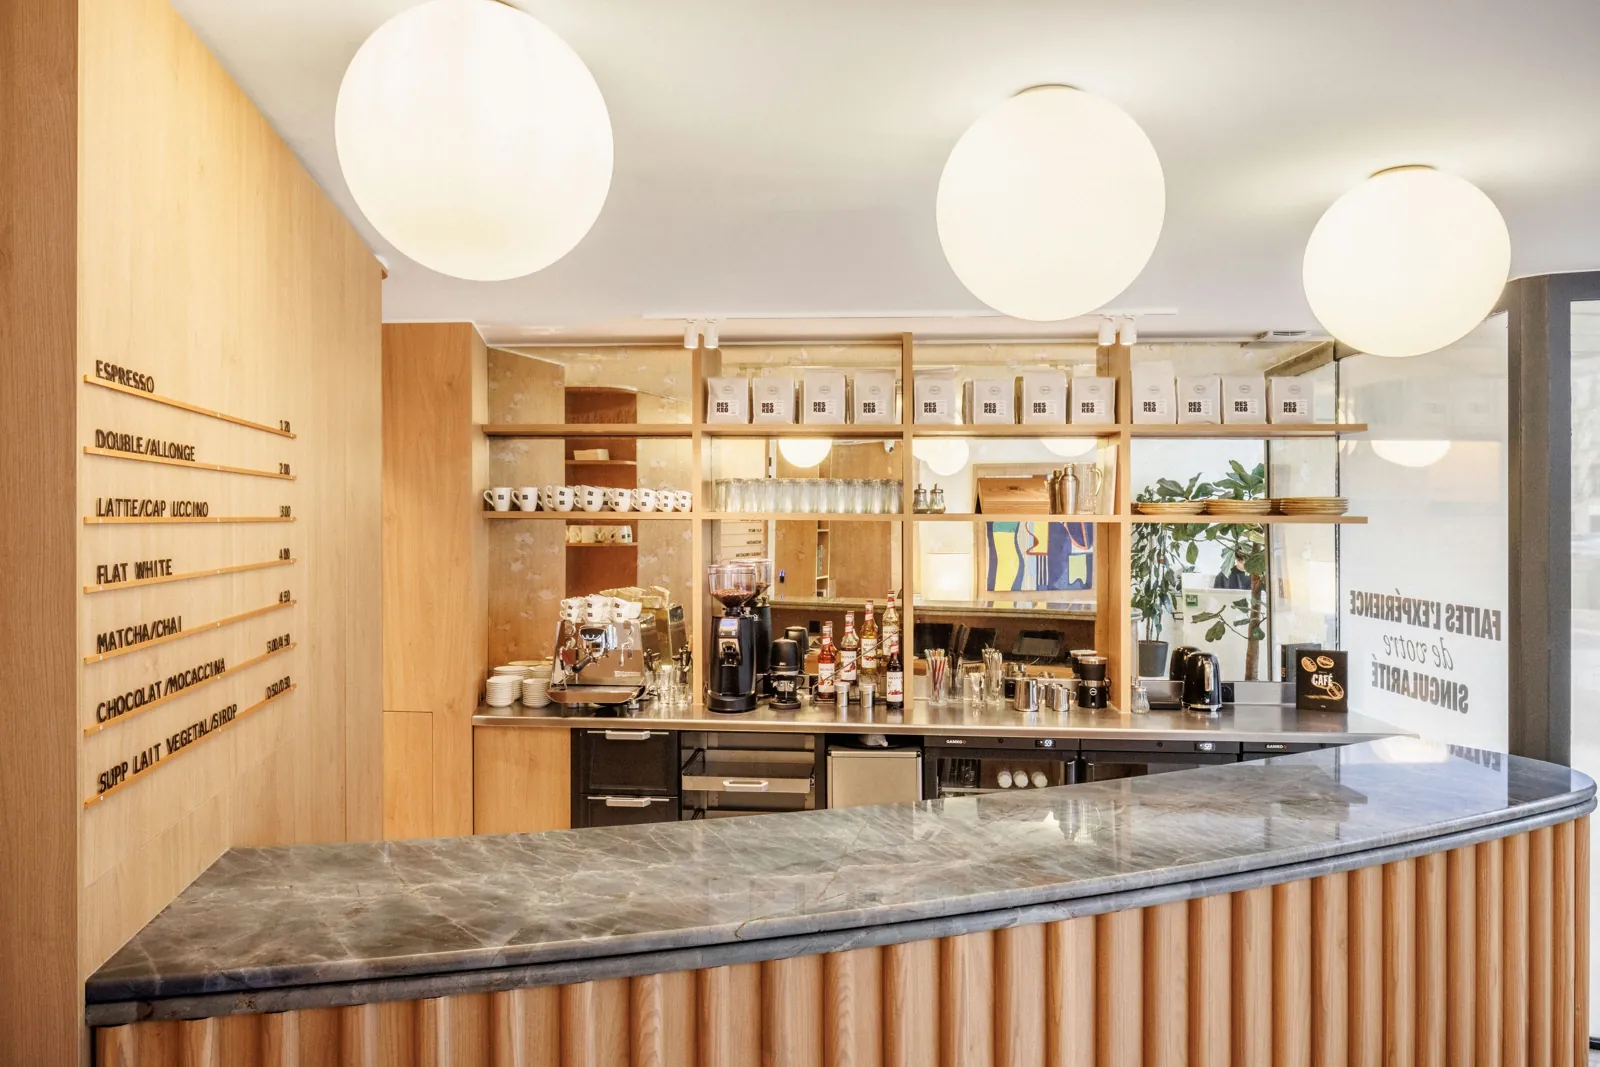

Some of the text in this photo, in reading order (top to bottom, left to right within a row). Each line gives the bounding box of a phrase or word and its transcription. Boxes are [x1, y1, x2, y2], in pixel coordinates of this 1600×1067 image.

[95, 359, 155, 393] ESPRESSO
[95, 429, 196, 462] DOUBLE/ALLONGE
[96, 558, 173, 584] FLAT WHITE
[96, 616, 182, 654] MATCHA/CHAI
[1311, 673, 1333, 687] CAFÉ
[97, 703, 238, 794] SUPP LAIT VEGETAL/SIROP
